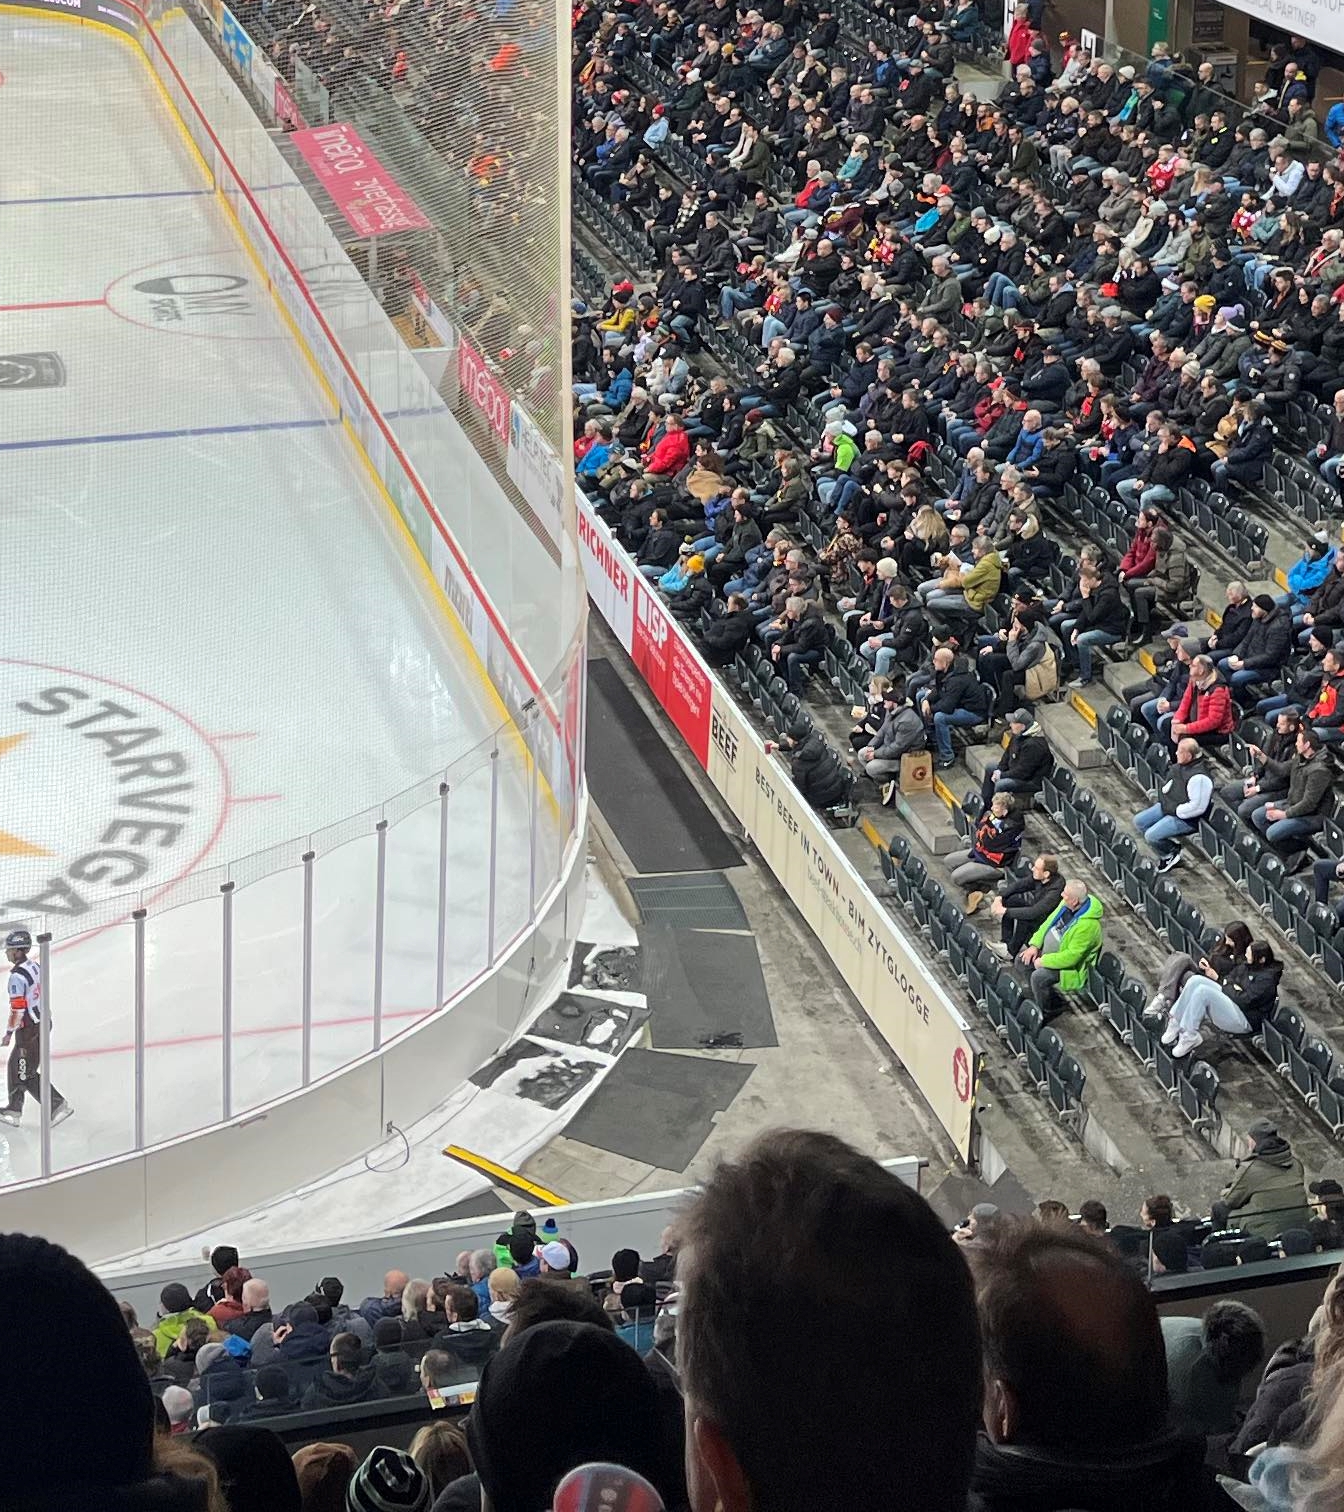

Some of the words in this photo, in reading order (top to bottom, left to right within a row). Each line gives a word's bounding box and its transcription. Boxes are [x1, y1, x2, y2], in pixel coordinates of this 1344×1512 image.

[1276, 0, 1317, 29] PARTNER
[576, 511, 630, 605] RICHNER
[712, 713, 738, 764] BEEF
[754, 763, 776, 799] BEST
[776, 798, 799, 838] BEEF
[799, 833, 811, 856] IN
[811, 850, 841, 898] TOWN
[848, 901, 867, 936] BIM
[866, 937, 930, 1026] ZYTGLOGGE
